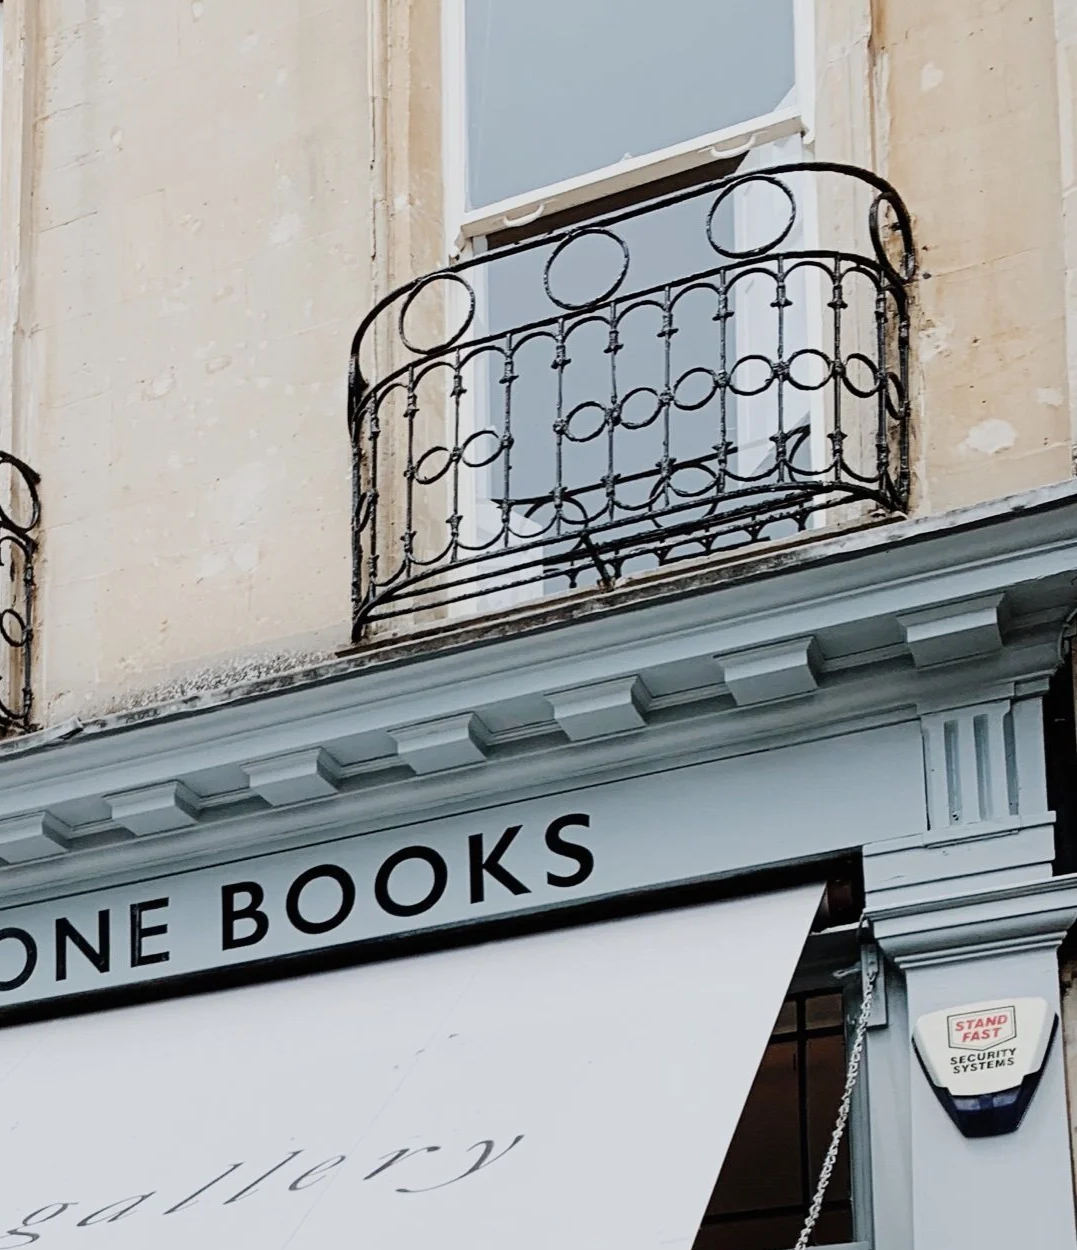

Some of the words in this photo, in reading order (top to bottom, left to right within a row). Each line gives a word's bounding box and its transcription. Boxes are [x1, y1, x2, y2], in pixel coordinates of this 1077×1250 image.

[221, 813, 595, 951] BOOKS
[955, 1014, 1008, 1032] STAND
[962, 1027, 1002, 1043] FAST
[950, 1048, 1016, 1065] SECURITY
[953, 1057, 1015, 1074] SYSTEMS
